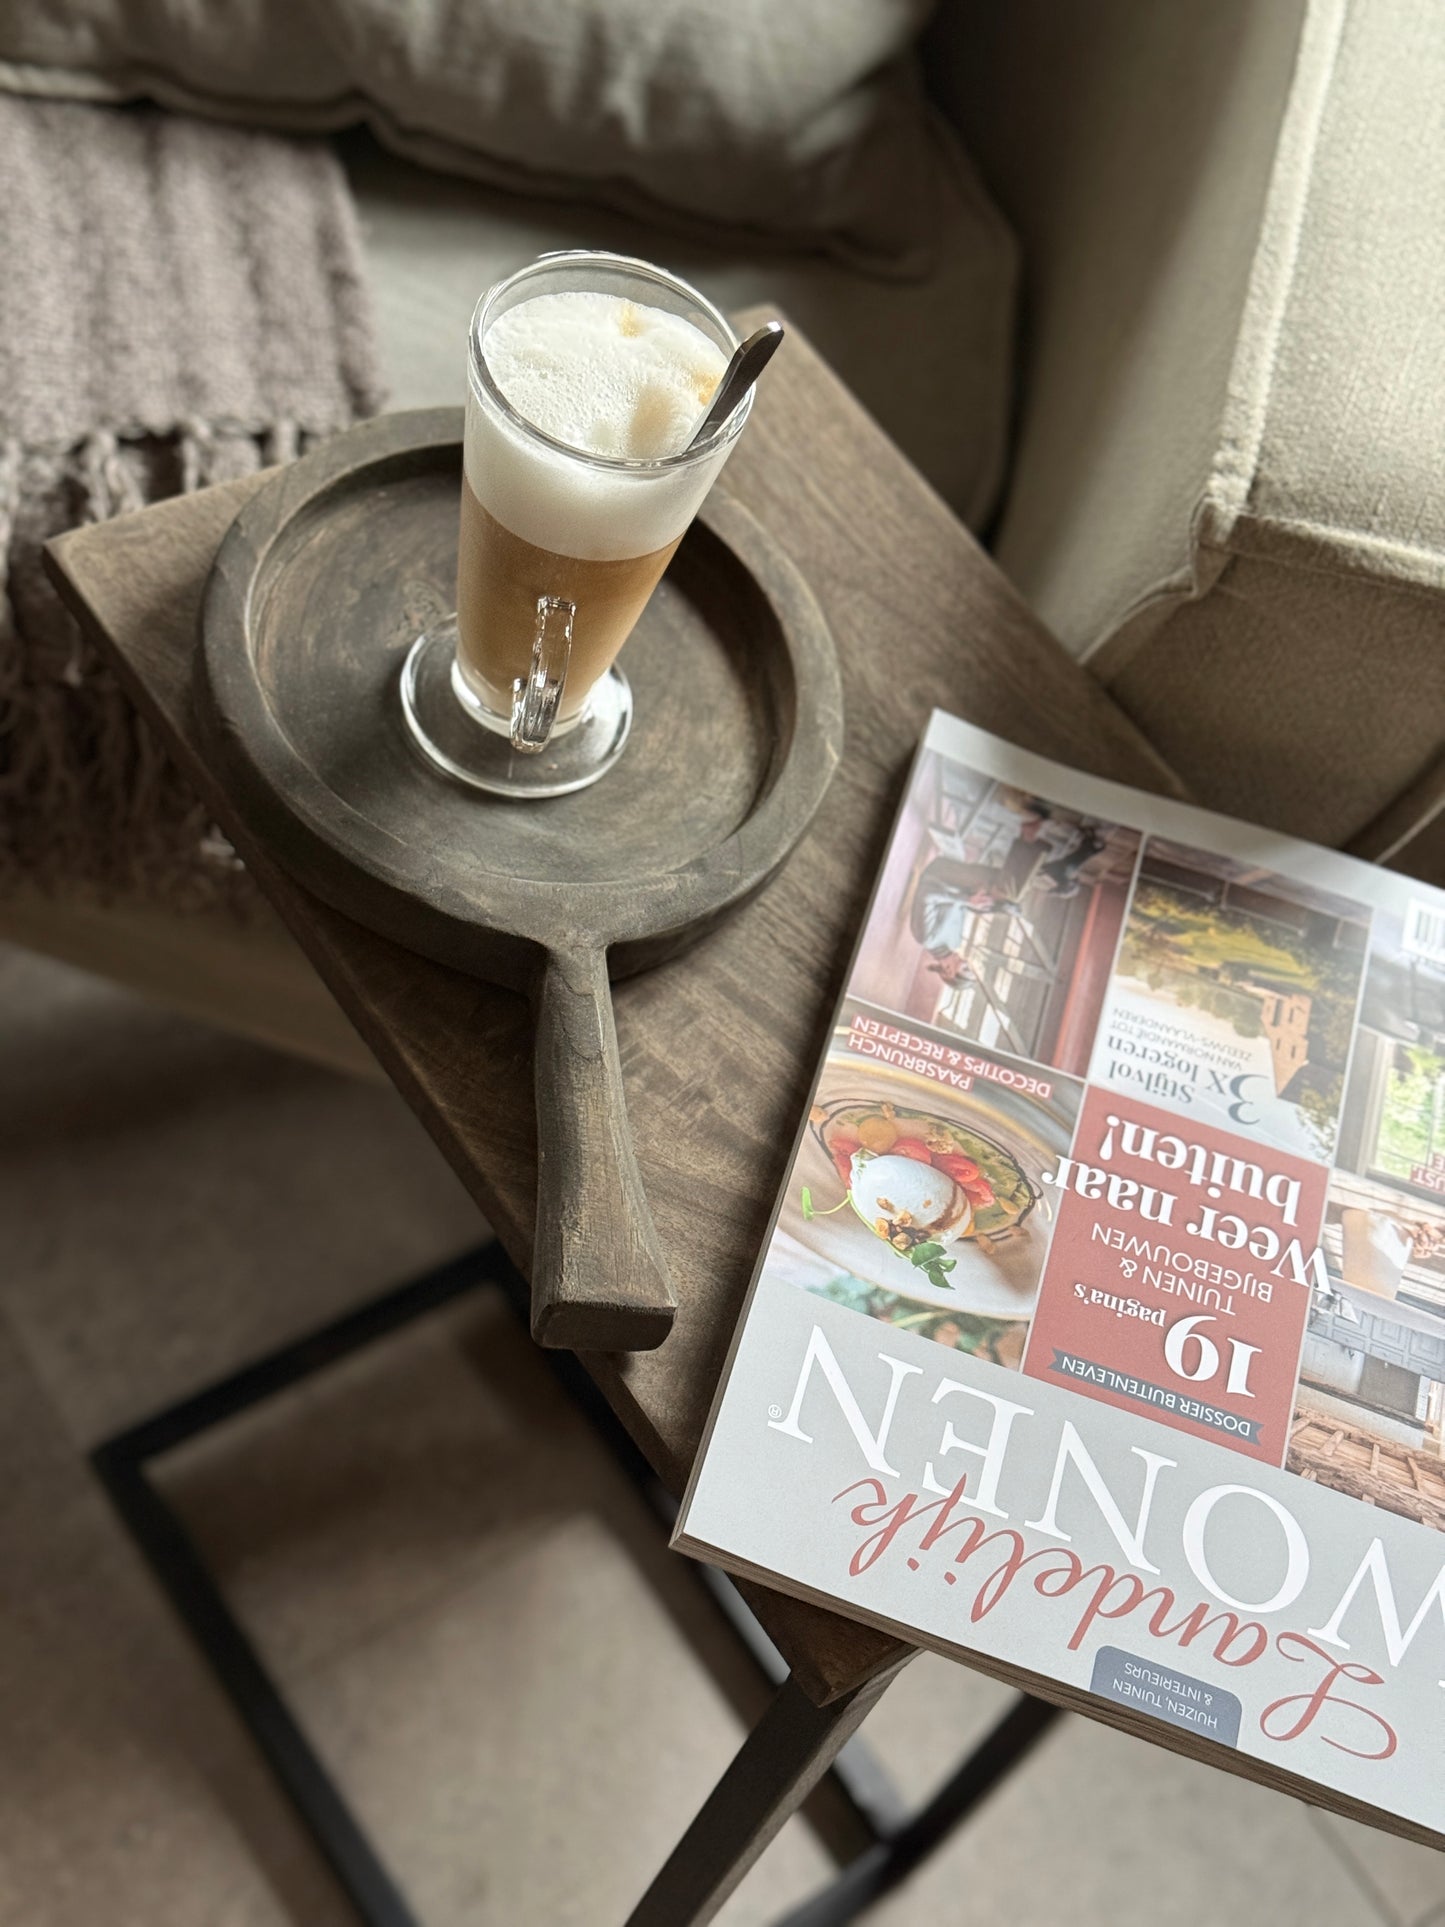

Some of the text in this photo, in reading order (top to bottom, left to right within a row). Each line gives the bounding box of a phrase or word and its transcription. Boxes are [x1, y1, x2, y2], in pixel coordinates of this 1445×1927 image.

[1111, 1019, 1135, 1034] TOT
[1112, 1007, 1253, 1062] ZEEUWS-VLAANDEREN
[849, 1034, 971, 1090] PAASBRUNCH
[854, 1015, 1052, 1099] DECOTIPS & RECEPTEN
[1107, 1035, 1199, 1082] logeren
[1108, 1060, 1196, 1104] Stijlvol
[1217, 1054, 1243, 1071] VAN
[1099, 1115, 1301, 1227] buiten!
[1041, 1154, 1335, 1297] Weer naar
[1090, 1222, 1273, 1303] BIJGEBOUWEN
[1118, 1257, 1238, 1316] TUINEN &
[1073, 1283, 1263, 1398] 19 pagina's
[1061, 1355, 1252, 1437] DOSSIER BUITENLEVEN
[767, 1325, 1445, 1687] WONEN
[832, 1473, 1398, 1760] Landelijk
[1112, 1678, 1218, 1729] HUIZEN, TUINEN
[1124, 1662, 1213, 1706] & INTERIEURS
